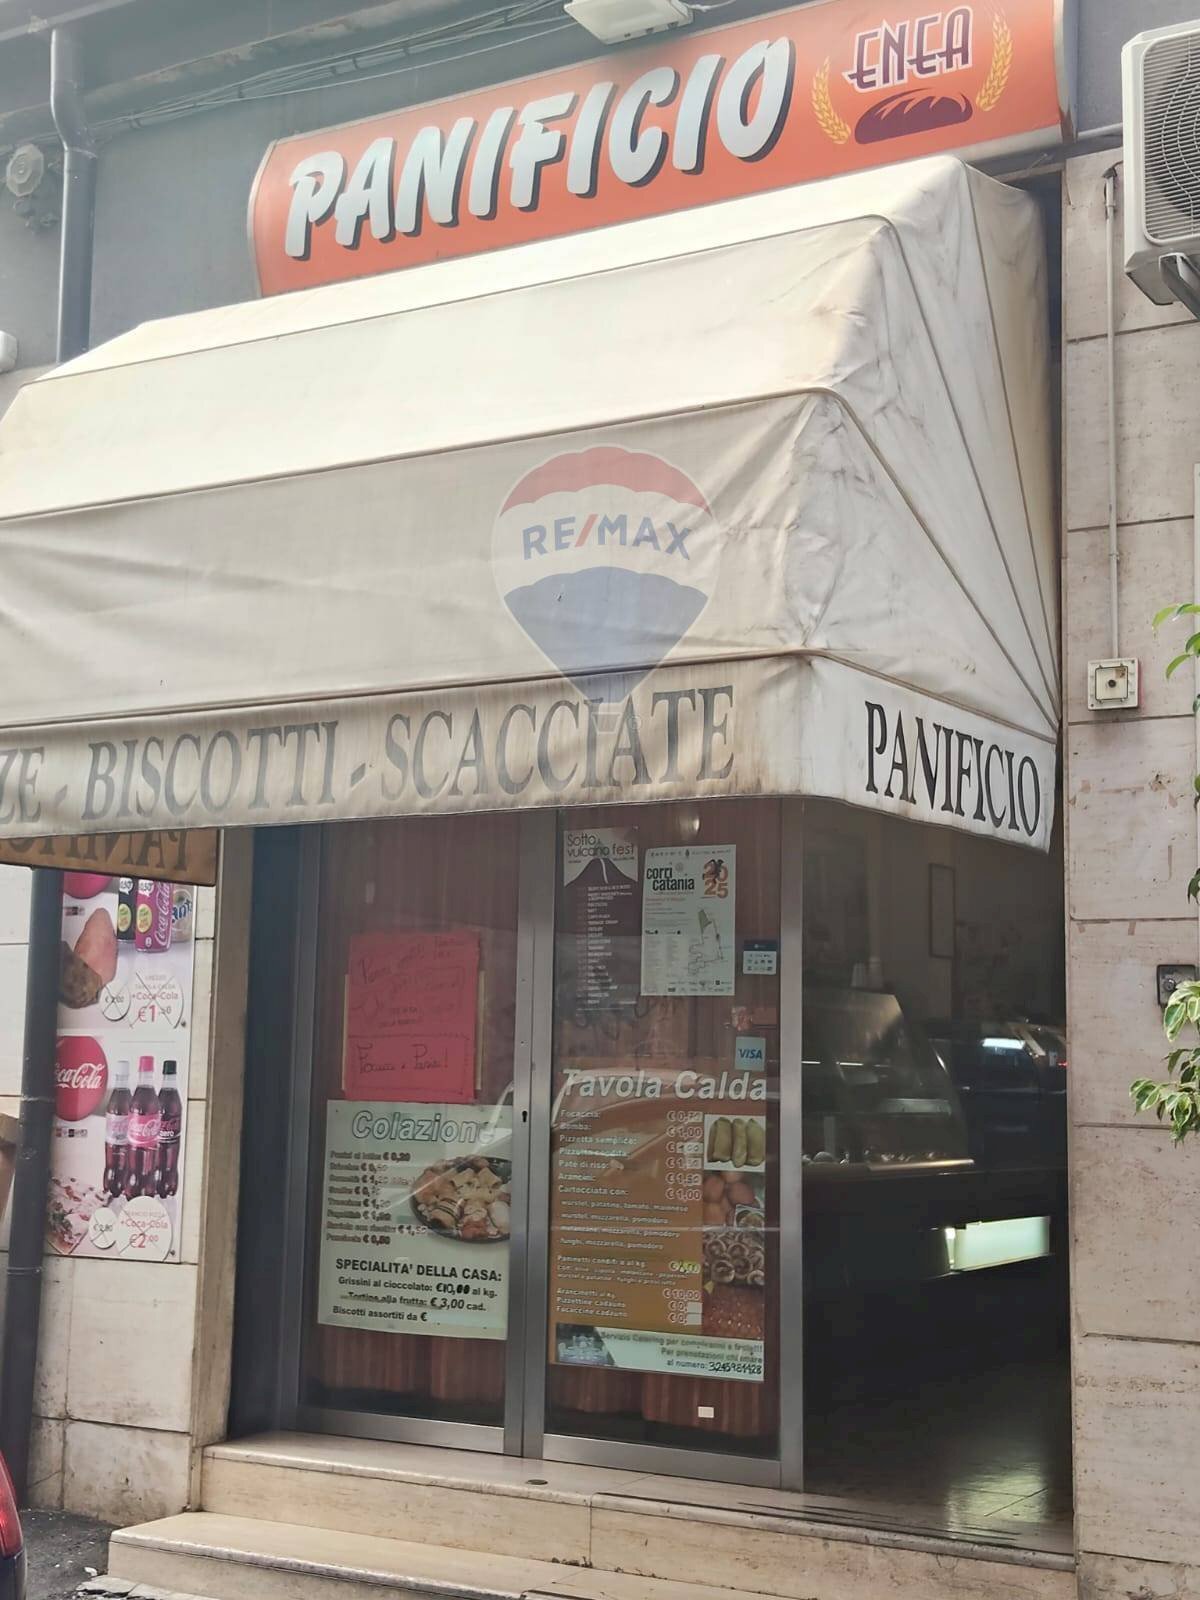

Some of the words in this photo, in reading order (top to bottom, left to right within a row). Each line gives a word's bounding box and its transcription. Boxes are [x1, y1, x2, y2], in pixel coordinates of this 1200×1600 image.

[843, 5, 974, 94] ENEA
[284, 36, 796, 261] PANIFICIO
[81, 719, 340, 820] BISCOTTI
[380, 684, 736, 800] SCACCIATE
[864, 700, 1042, 838] PANIFICIO
[567, 833, 596, 847] Sotto
[612, 842, 634, 855] fest
[646, 862, 673, 880] corri
[652, 875, 695, 892] catania
[703, 879, 728, 899] 25
[739, 1048, 763, 1060] VISA
[562, 1068, 662, 1099] Tavola
[674, 1070, 767, 1101] Calda
[677, 1127, 703, 1139] 1,00
[675, 1188, 703, 1200] 1,00
[335, 1258, 413, 1275] SPECIALITA'
[416, 1264, 458, 1279] DELLA
[461, 1268, 503, 1282] CASA:
[338, 1276, 371, 1288] Grissini
[372, 1278, 381, 1288] al
[383, 1279, 433, 1292] cioccolato:
[440, 1297, 465, 1311] 3,00
[332, 1305, 366, 1317] Biscotti
[368, 1309, 405, 1321] assortiti
[406, 1312, 418, 1322] da
